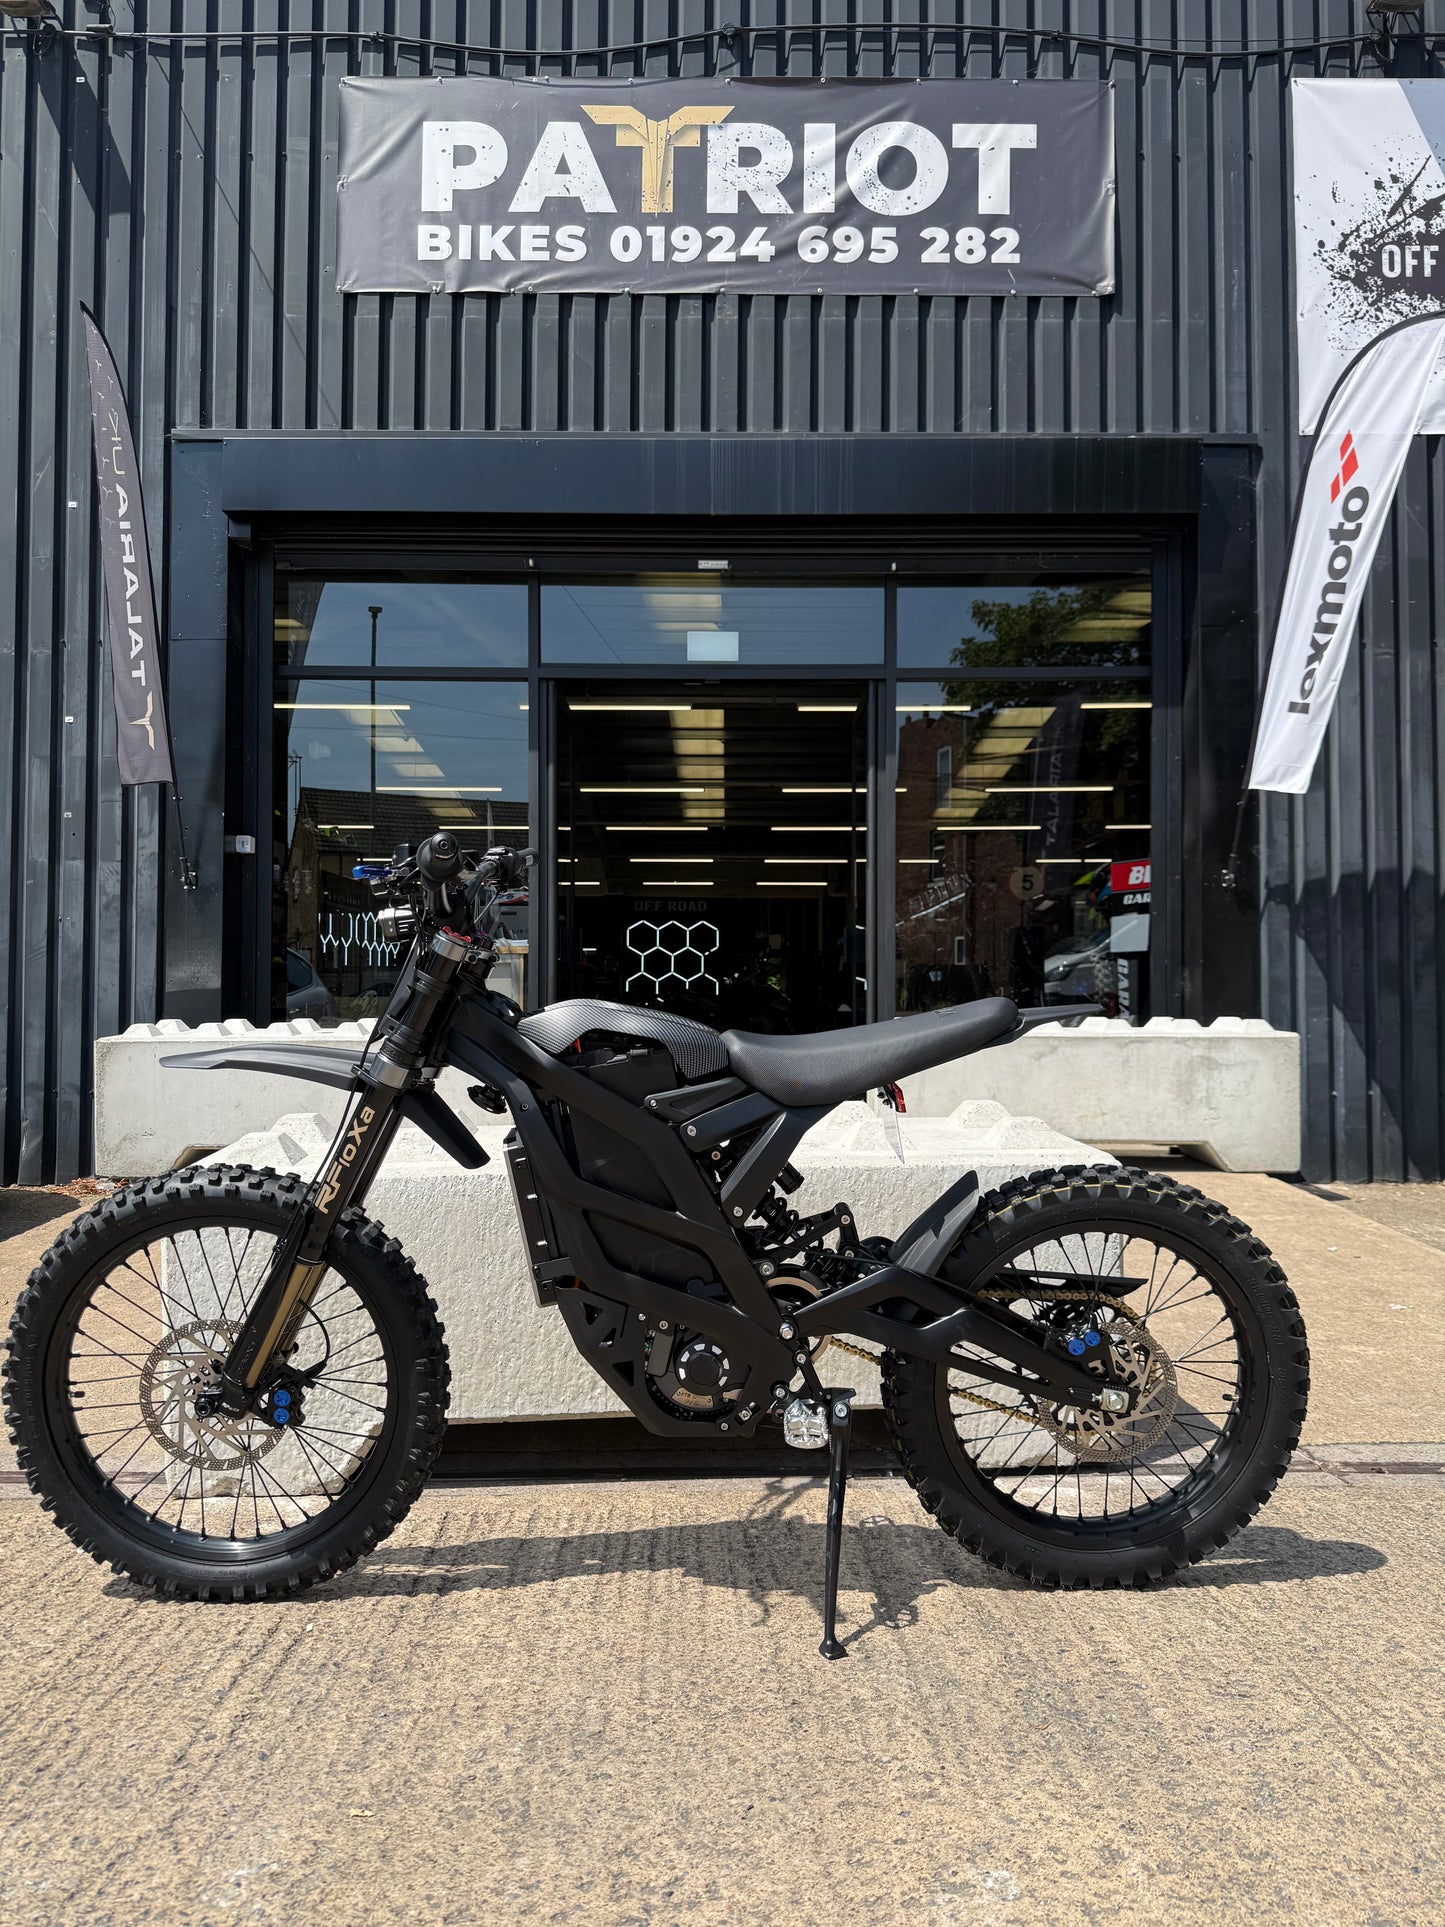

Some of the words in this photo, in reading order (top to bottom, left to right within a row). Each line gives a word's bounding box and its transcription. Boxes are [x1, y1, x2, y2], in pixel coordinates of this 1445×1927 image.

[421, 105, 1037, 216] PATRIOT
[417, 225, 588, 262] BIKES
[609, 225, 776, 263] 01924
[797, 226, 899, 264] 695
[919, 227, 1021, 264] 282
[1381, 244, 1440, 278] OFF
[1287, 486, 1370, 715] lexmoto
[1022, 874, 1034, 891] 5
[634, 900, 664, 912] OFF
[667, 900, 708, 912] ROAD
